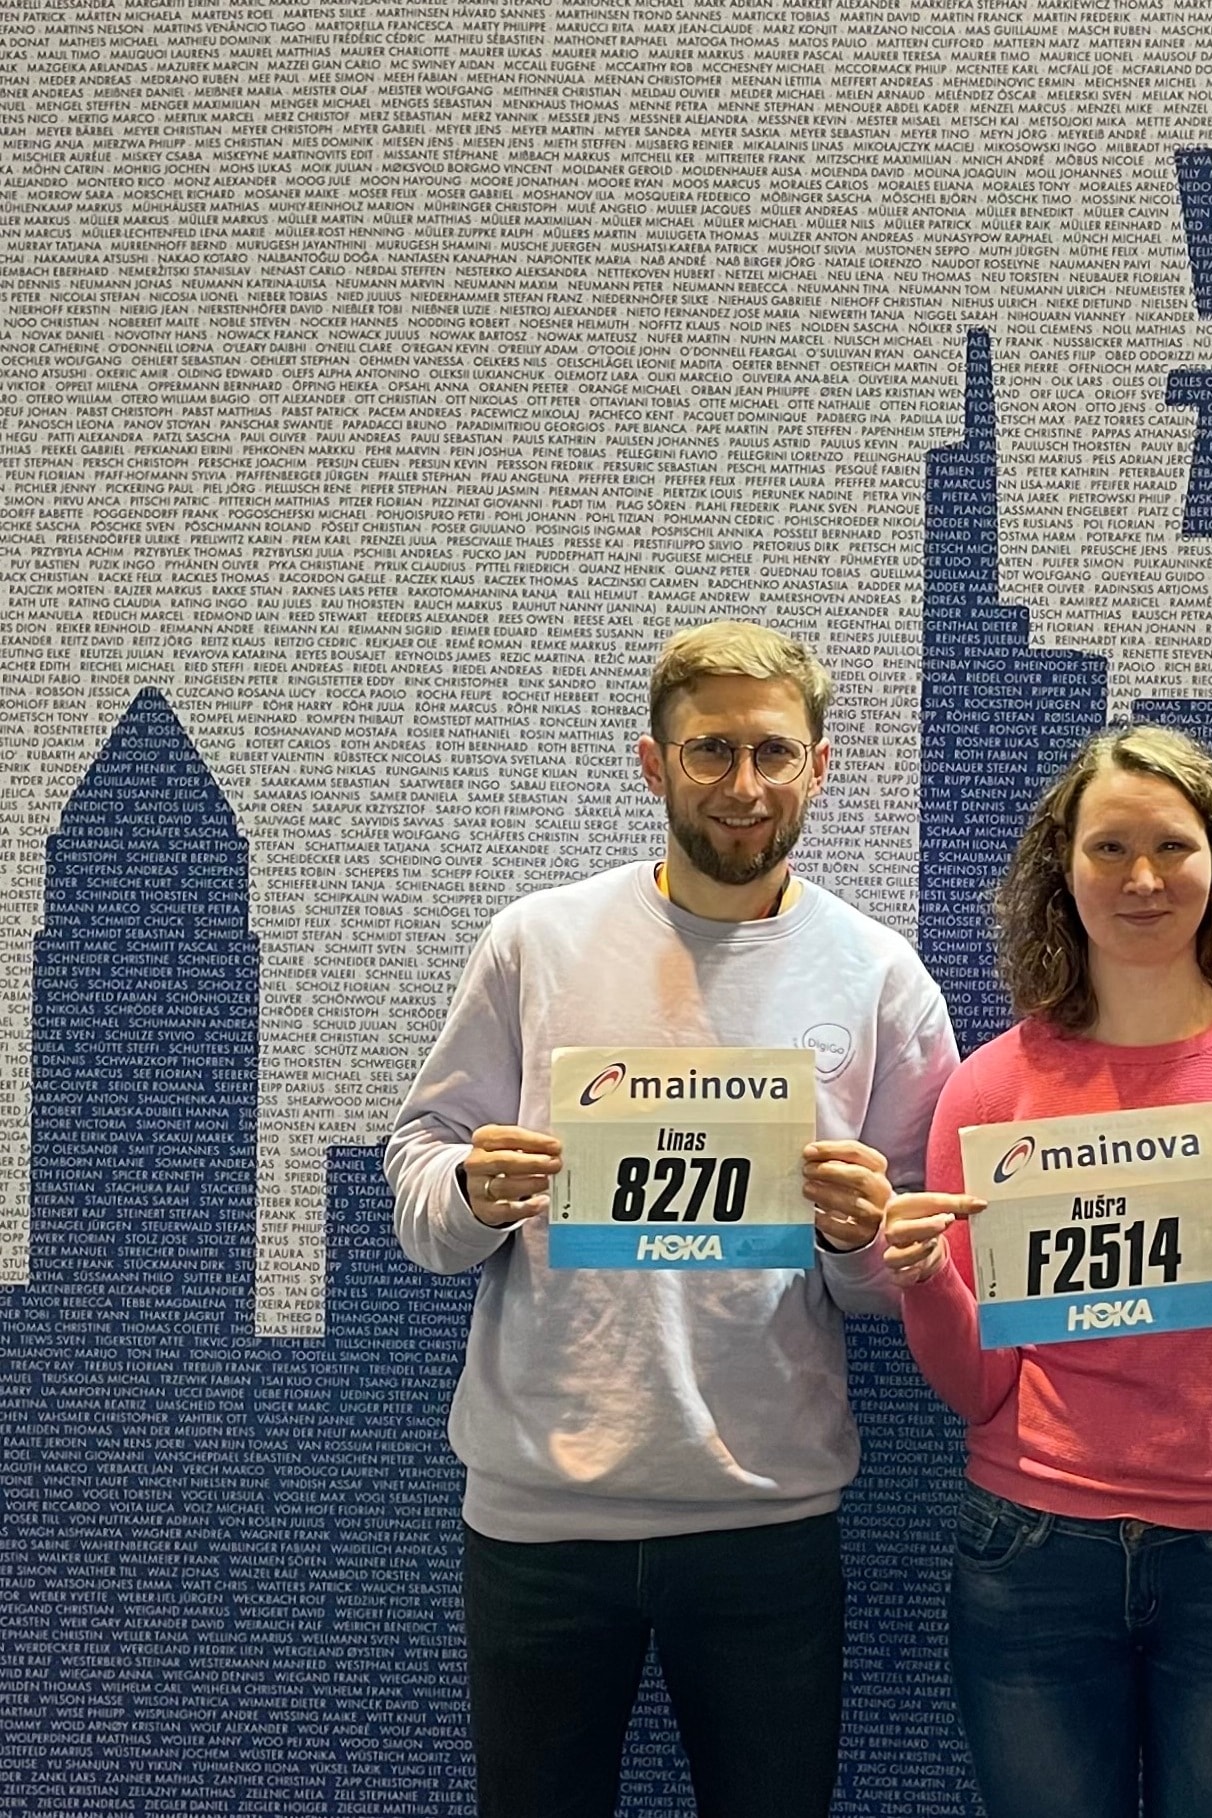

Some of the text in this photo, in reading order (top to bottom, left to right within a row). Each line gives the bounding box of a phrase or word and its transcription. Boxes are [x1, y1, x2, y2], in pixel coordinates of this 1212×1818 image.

[950, 50, 1031, 62] MAURER TIMO
[934, 88, 1037, 101] MELÉNDEZ ÓSCAR
[502, 99, 709, 112] MENKHAUS THOMAS MENNE PETRA
[1076, 103, 1152, 115] MENZEL MIKE
[67, 111, 255, 124] MERTIG MARCO MARCEL
[112, 163, 211, 176] MOHRIG JOCHEN
[561, 164, 674, 176] MOLDANER GEROLD
[76, 176, 166, 188] MONTERO RICO
[512, 434, 720, 448] PAULS KATHRIN PAULSEN JOHANNES
[40, 444, 126, 456] PEEKEL GABRIEL
[82, 457, 189, 469] PERSCH CHRISTOPH
[496, 459, 595, 471] PERSSON FREDRIK
[92, 508, 219, 520] POGGENDORFF FRANK
[340, 827, 461, 841] SCHÄFER WOLFGANG
[378, 854, 483, 867] SCHEIDING OLIVER
[344, 866, 422, 879] SCHEPERS TIM
[75, 889, 198, 902] SCHINDLER THORSTEN
[71, 927, 185, 940] SCHMIDT SEBASTIAN
[83, 940, 219, 953] MARC SCHMITT PASCAL
[807, 1037, 845, 1055] DigiGo
[630, 1068, 788, 1099] mainova
[657, 1127, 707, 1151] Linas
[1041, 1133, 1200, 1171] mainova
[611, 1156, 752, 1222] 8270
[1071, 1194, 1126, 1221] Aušra
[636, 1234, 723, 1261] HOKA
[1026, 1216, 1182, 1297] F2514
[1067, 1298, 1154, 1332] HOKA
[181, 1464, 266, 1476] VERCH MARCO
[137, 1476, 271, 1490] VINCENT NIELSEN RUNE
[183, 1502, 266, 1515] VOLZ MICHAEL
[100, 1681, 304, 1696] WILHELM CARL WILHELM CHRISTIAN
[189, 1721, 288, 1736] WOLF ALEXANDER
